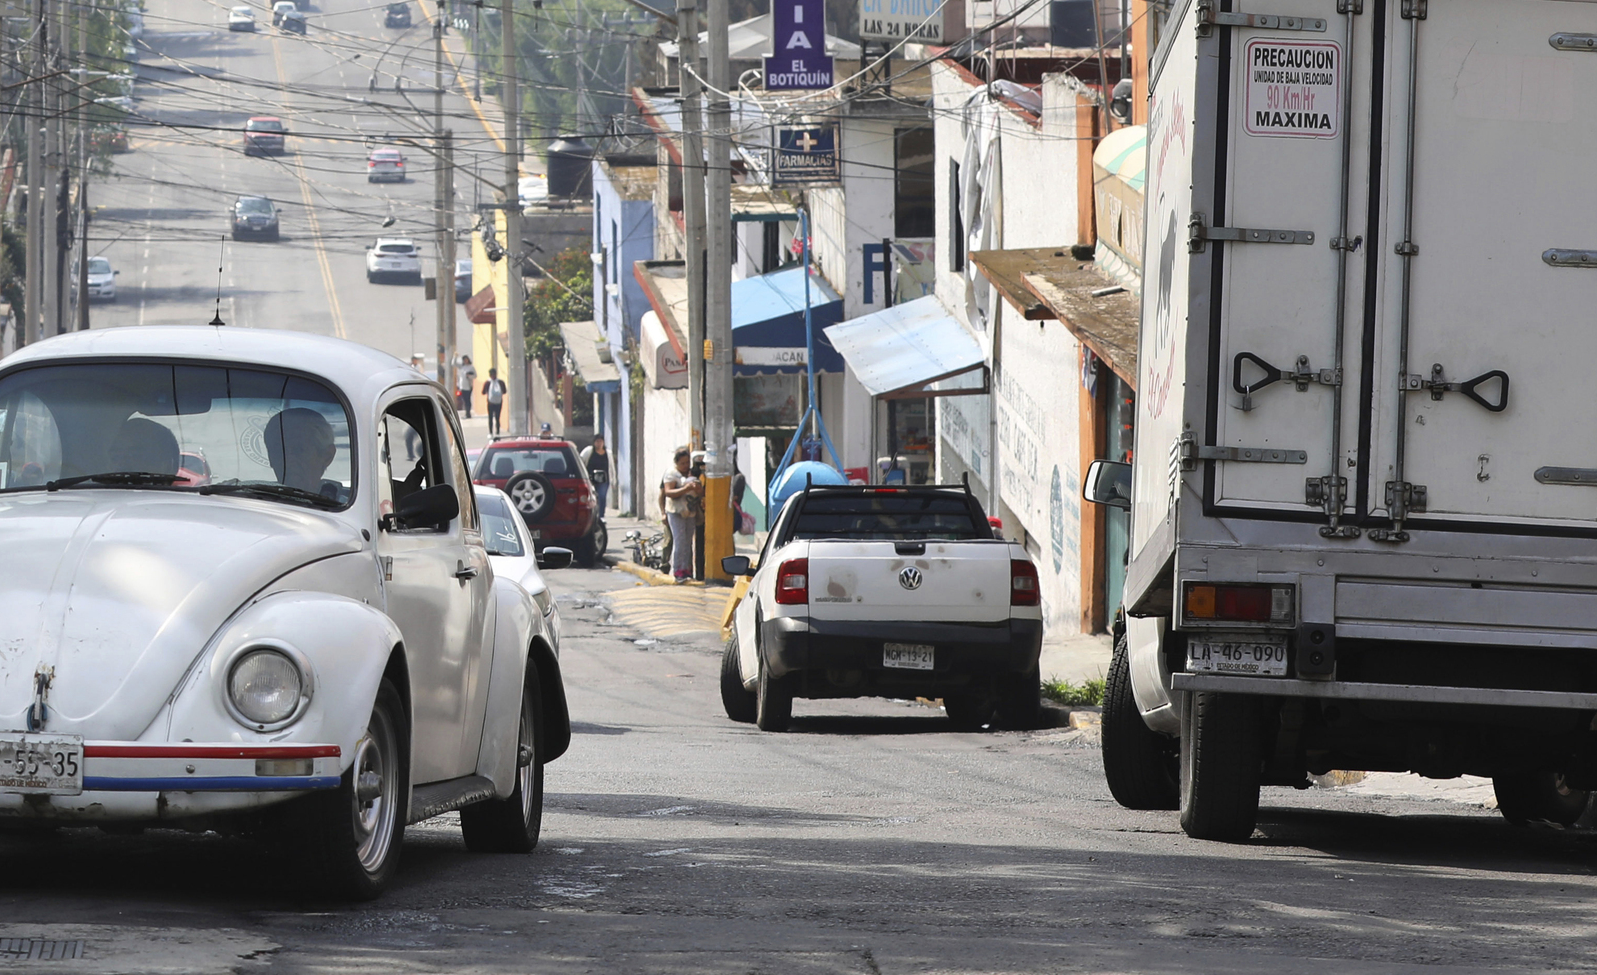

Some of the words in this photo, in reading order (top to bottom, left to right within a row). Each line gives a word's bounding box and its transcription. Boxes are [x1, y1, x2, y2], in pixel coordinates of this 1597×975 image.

[864, 19, 882, 34] LAS
[887, 22, 900, 36] 24
[904, 21, 939, 39] HORAS
[791, 60, 807, 72] EL
[769, 70, 830, 86] BOTIQUÍN
[1254, 70, 1276, 83] UNIDAD
[1276, 71, 1284, 84] DE
[1285, 71, 1300, 84] BAJA
[1301, 72, 1333, 85] VELOCIDAD
[1267, 85, 1280, 109] 90
[1283, 86, 1315, 110] Km/Hr
[1256, 111, 1331, 129] MAXIMA
[885, 649, 932, 663] MGM-13-21
[1191, 643, 1284, 662] LA-46-090
